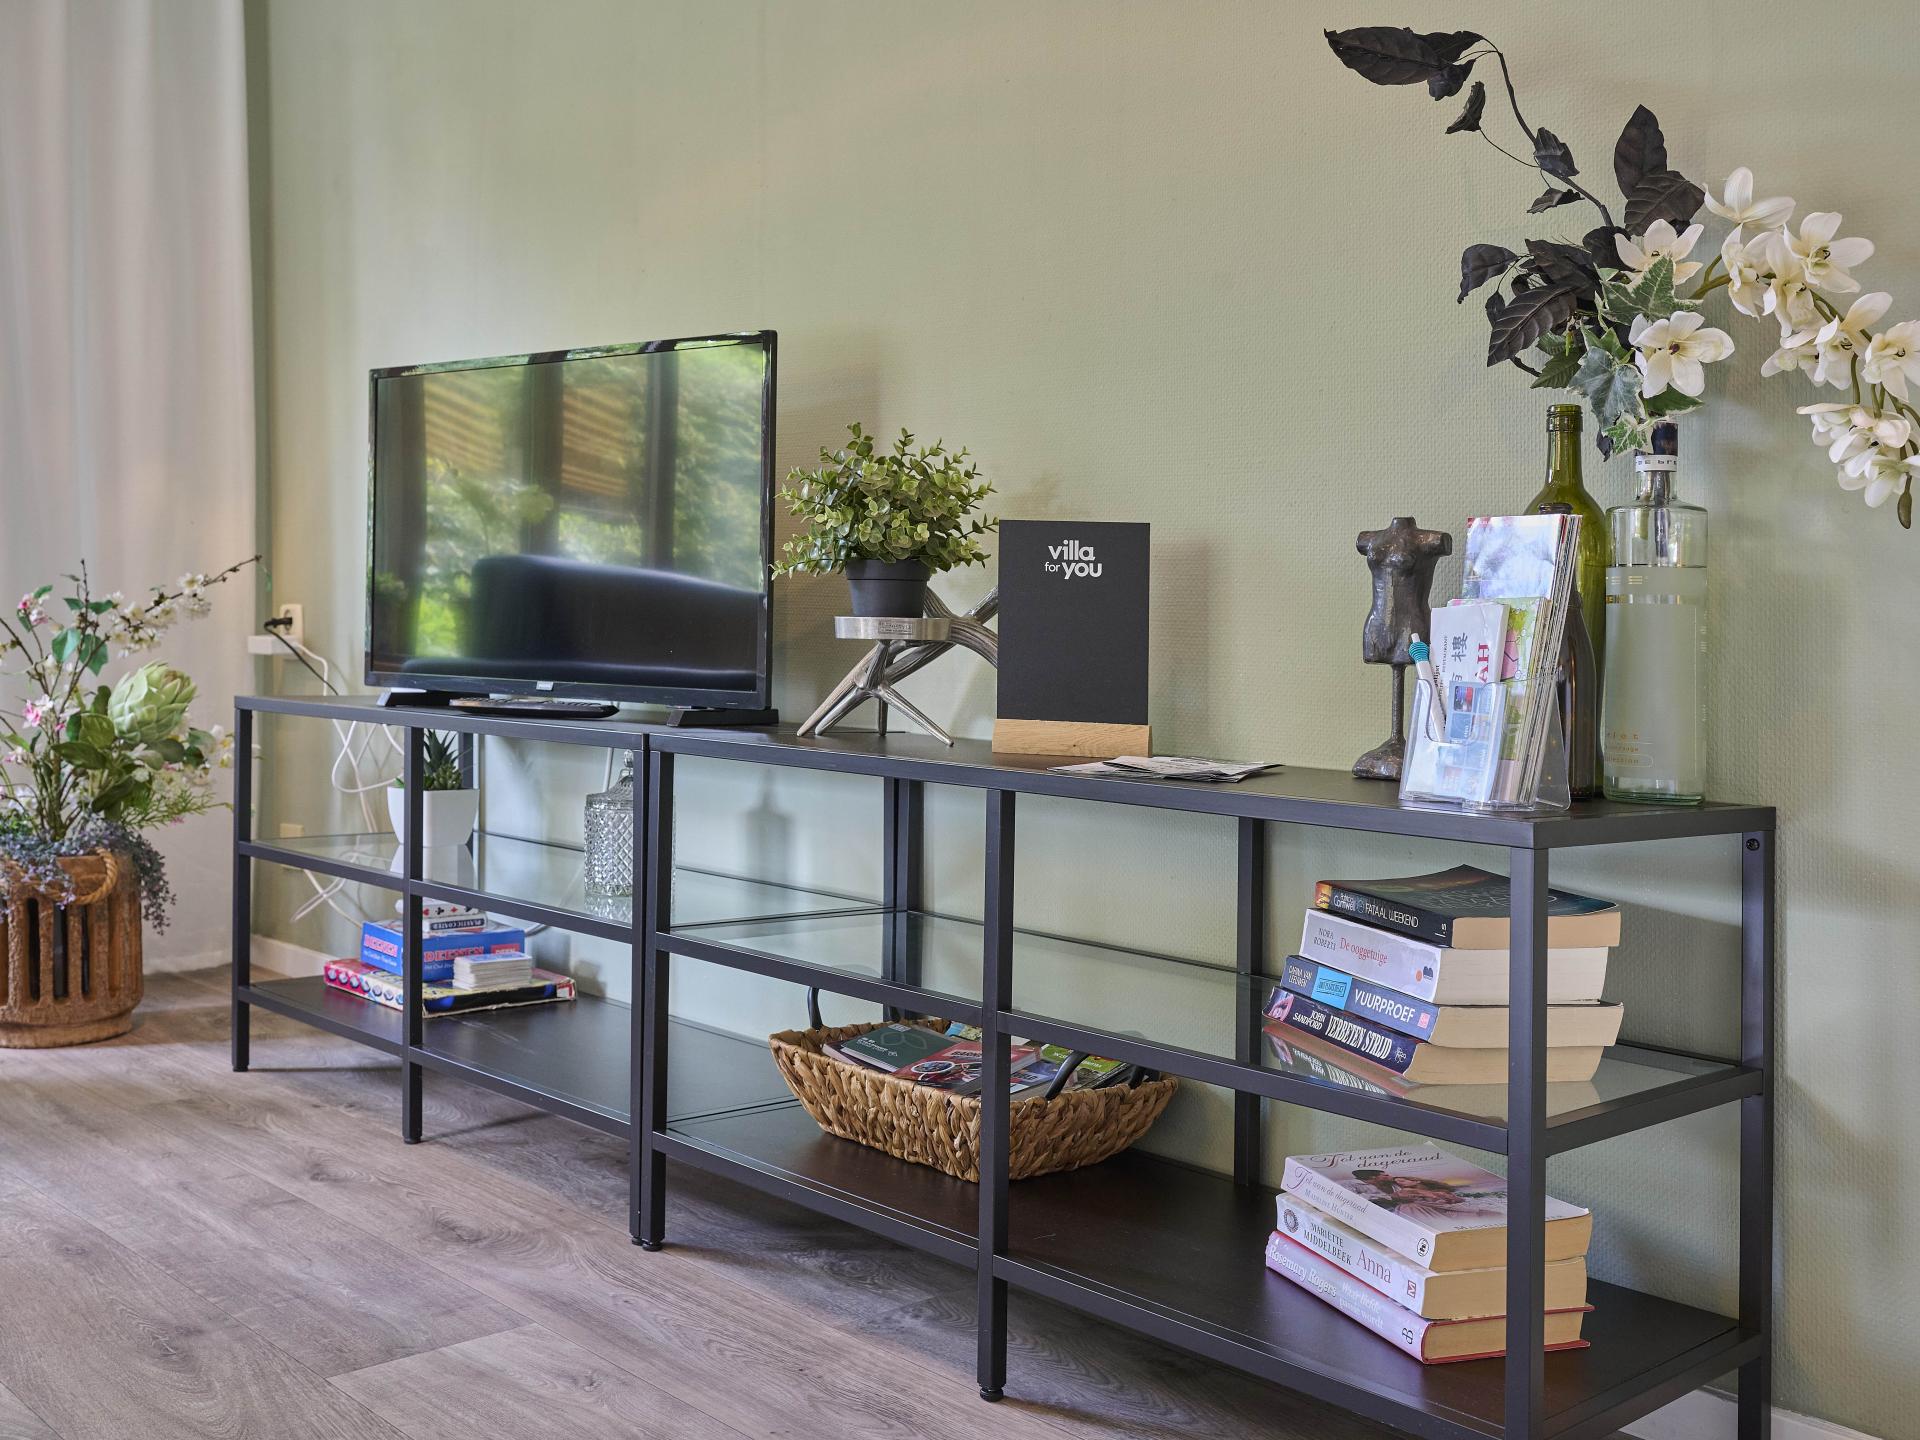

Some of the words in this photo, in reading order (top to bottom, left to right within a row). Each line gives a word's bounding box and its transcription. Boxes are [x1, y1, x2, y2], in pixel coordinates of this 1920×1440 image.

[1048, 539, 1096, 561] villa
[1044, 561, 1060, 572] for
[1061, 562, 1102, 580] you
[432, 921, 457, 930] COATED
[457, 919, 482, 928] PLASTIC
[1365, 902, 1388, 920] FATAAL
[1388, 910, 1419, 928] WEEKEND
[1313, 937, 1336, 951] ROBERTS
[1319, 928, 1334, 940] NORA
[1340, 937, 1351, 951] De
[1351, 944, 1388, 966] ooggetuige
[1311, 1009, 1327, 1023] JOHN
[1355, 989, 1416, 1023] VUURPROEF
[1292, 1012, 1323, 1031] SANDFORD
[1325, 1015, 1367, 1049] VERBETEN
[1361, 1031, 1393, 1060] STRIJD
[1357, 1152, 1443, 1168] dageraad
[1286, 1166, 1313, 1190] Tot
[1310, 1222, 1345, 1248] MARIETTE
[1303, 1230, 1352, 1266] MIDDELBEEK
[1268, 1245, 1307, 1283] Rosemary
[1307, 1265, 1337, 1298] Rogers
[1357, 1248, 1392, 1284] Anna
